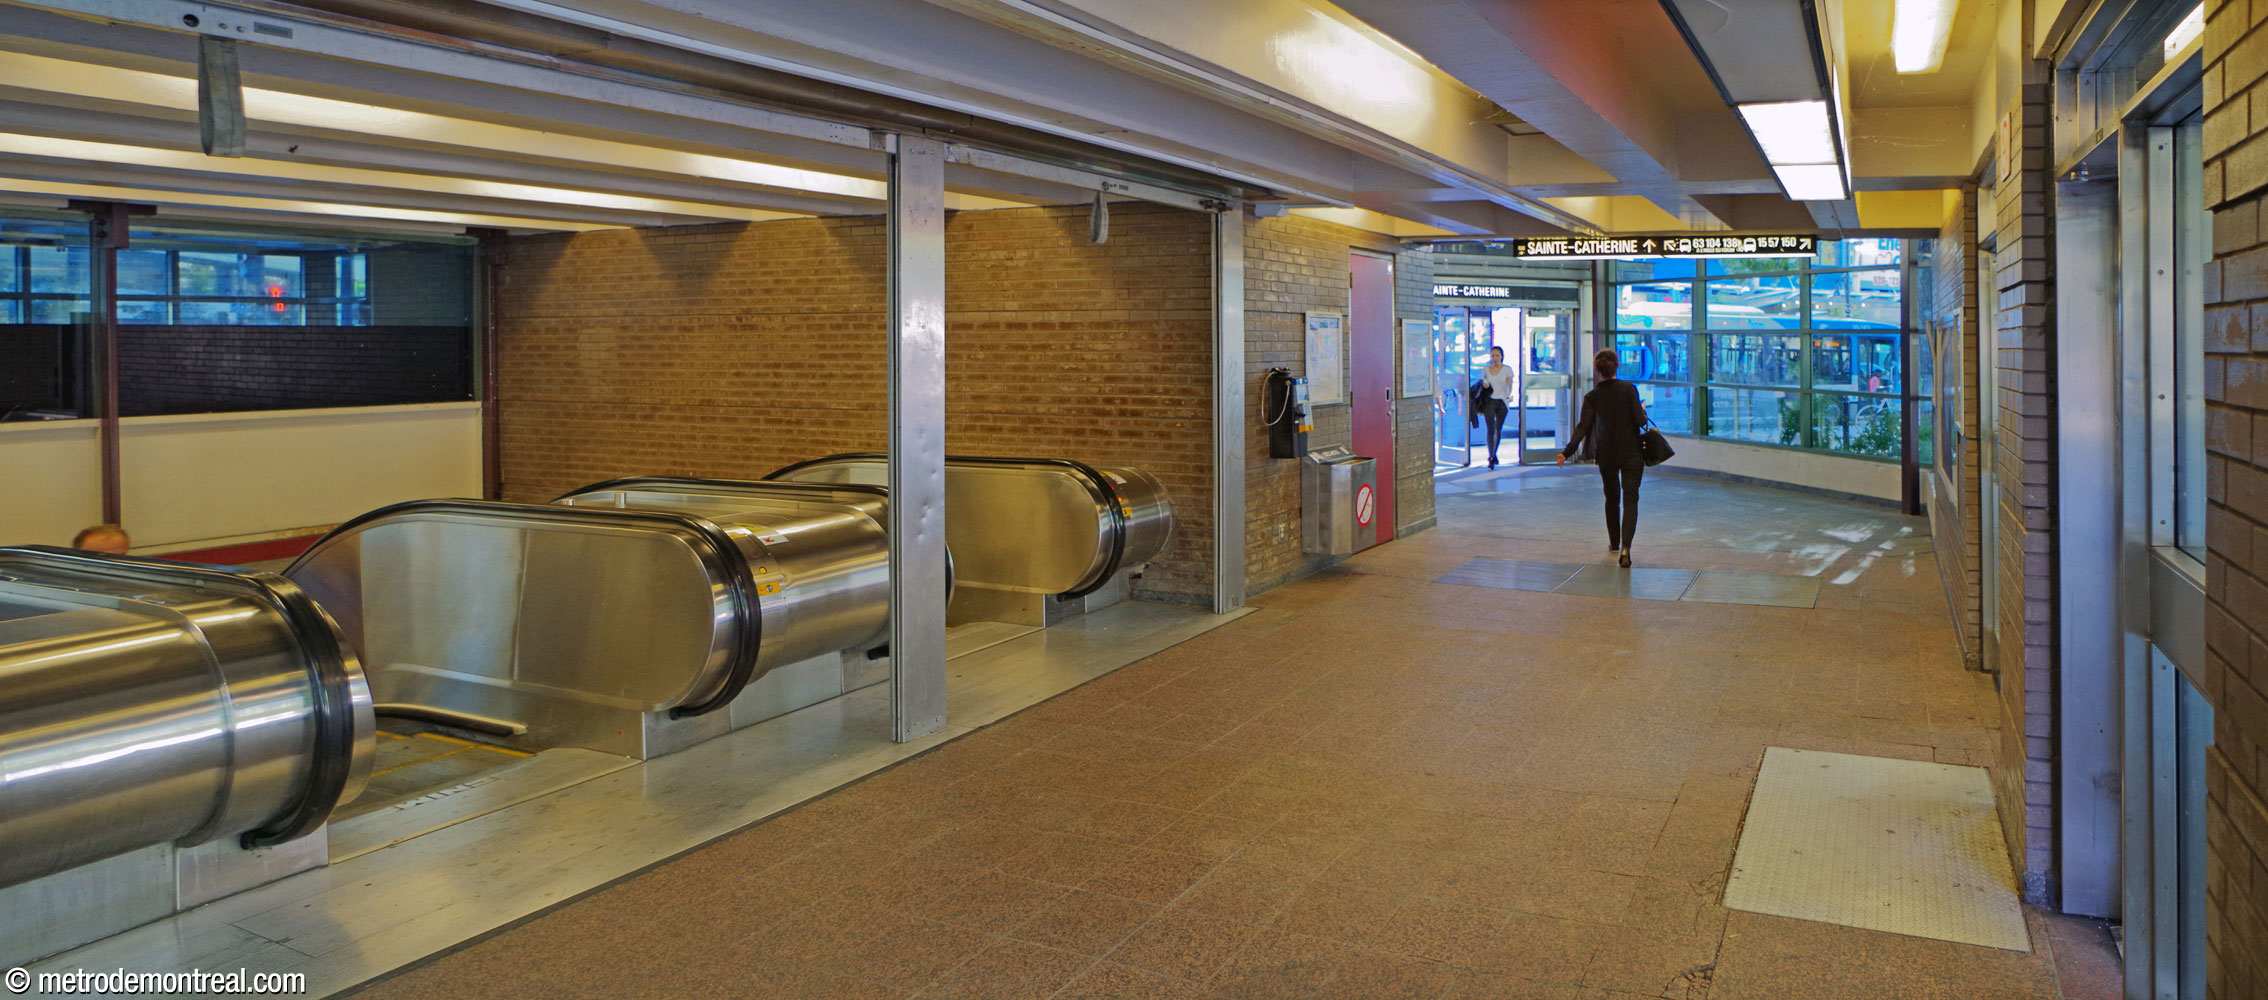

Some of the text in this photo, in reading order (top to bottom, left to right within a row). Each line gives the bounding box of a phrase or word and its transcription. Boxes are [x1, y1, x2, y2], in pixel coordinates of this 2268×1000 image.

[1692, 239, 1738, 248] 63 104 138
[1757, 236, 1796, 247] 15 57 150
[1527, 240, 1638, 255] SAINTE-CATHERINE
[1432, 285, 1510, 297] AINTE-CATHERINE
